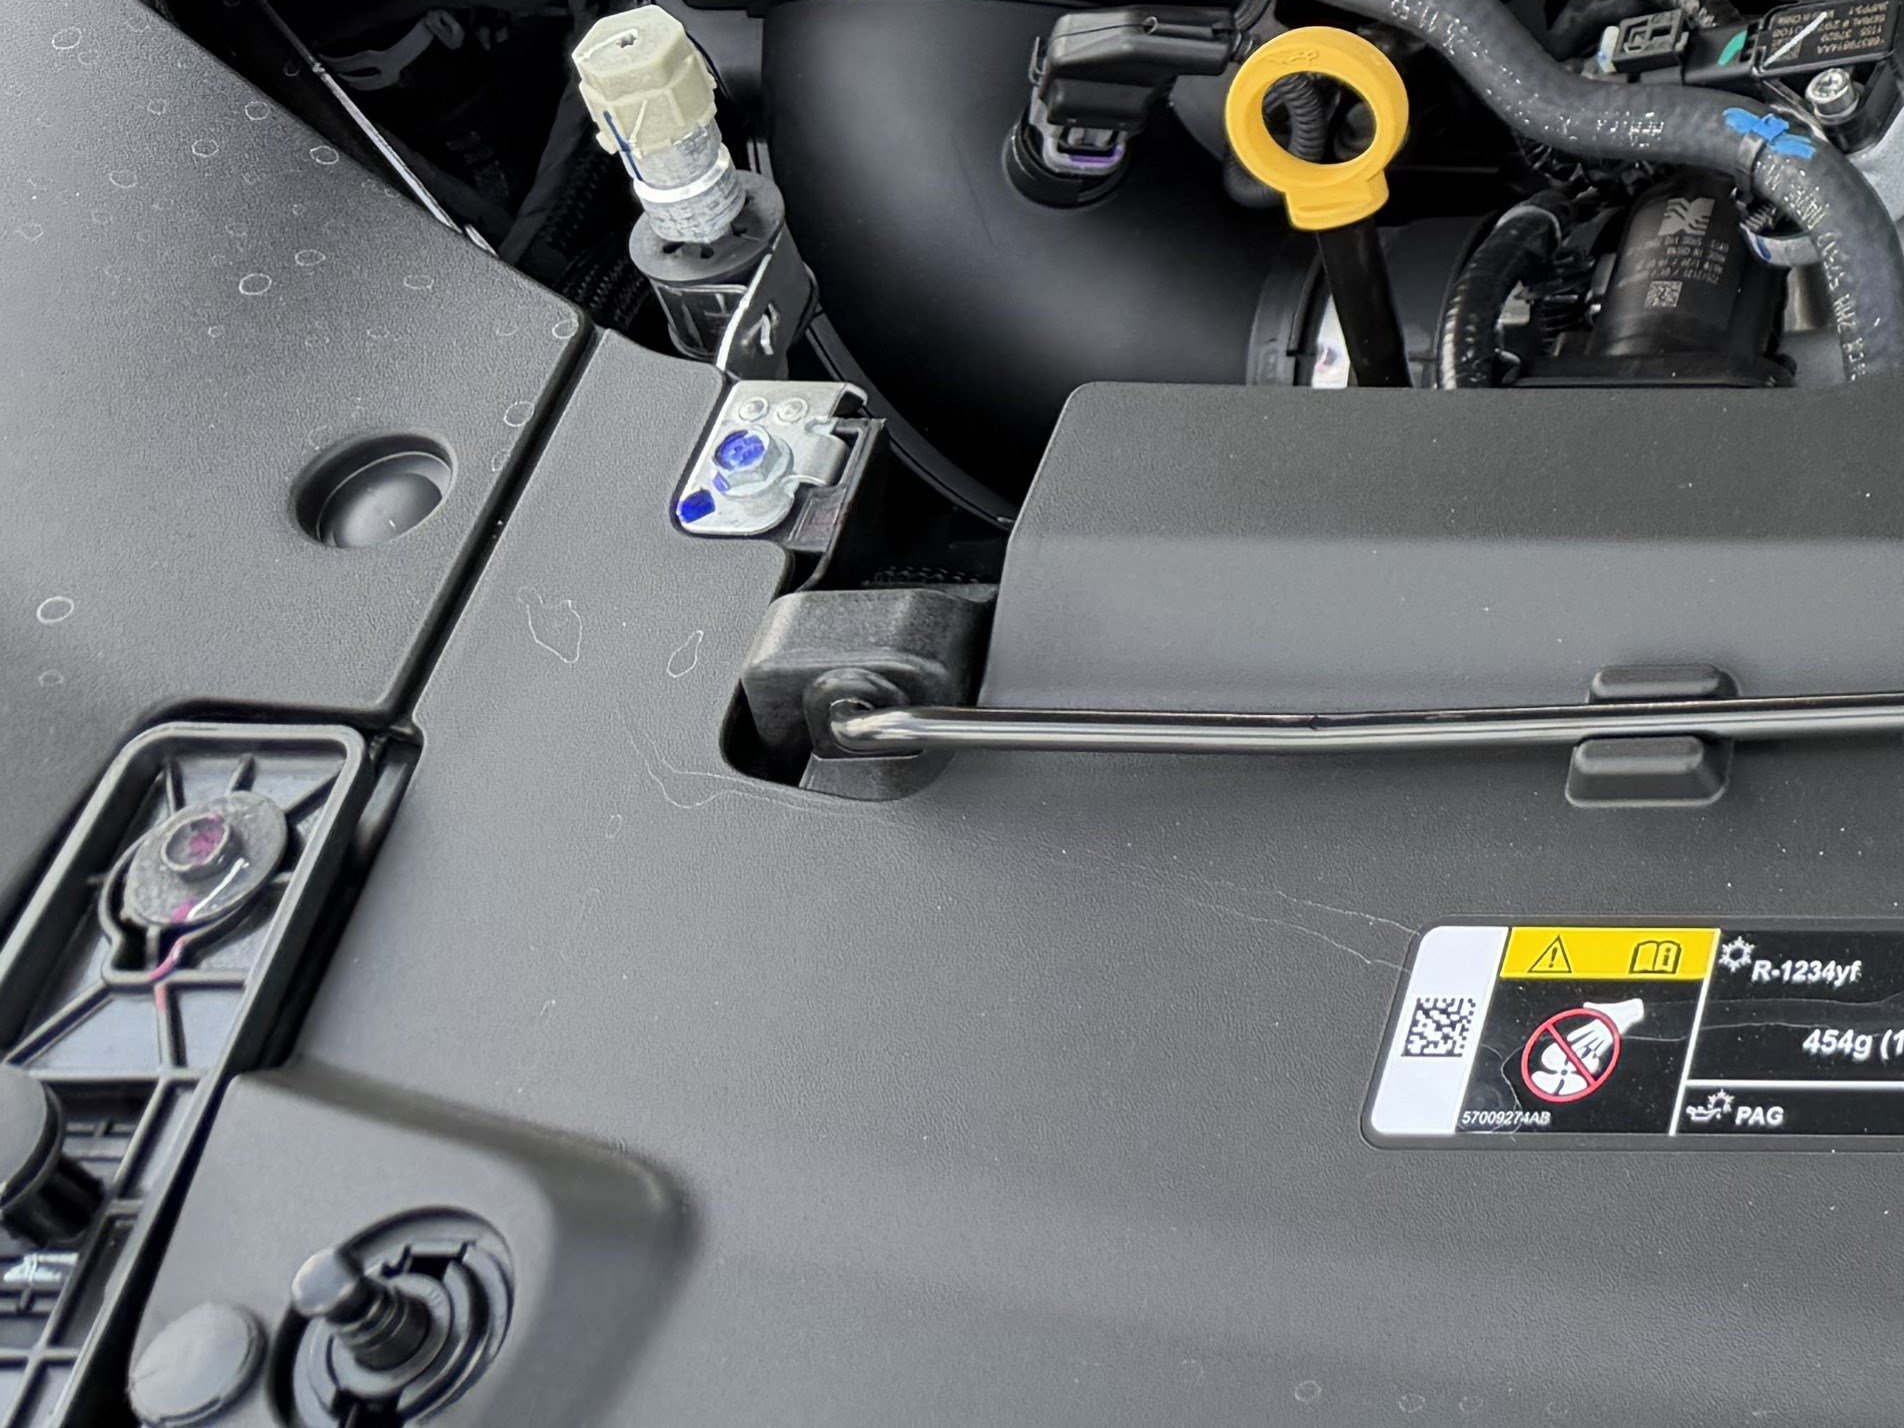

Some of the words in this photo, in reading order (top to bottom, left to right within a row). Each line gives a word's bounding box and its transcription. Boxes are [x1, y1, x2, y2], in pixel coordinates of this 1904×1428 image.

[1753, 961, 1860, 986] R-1234yf
[1802, 1030, 1874, 1060] 454g
[1734, 1106, 1785, 1127] PAG
